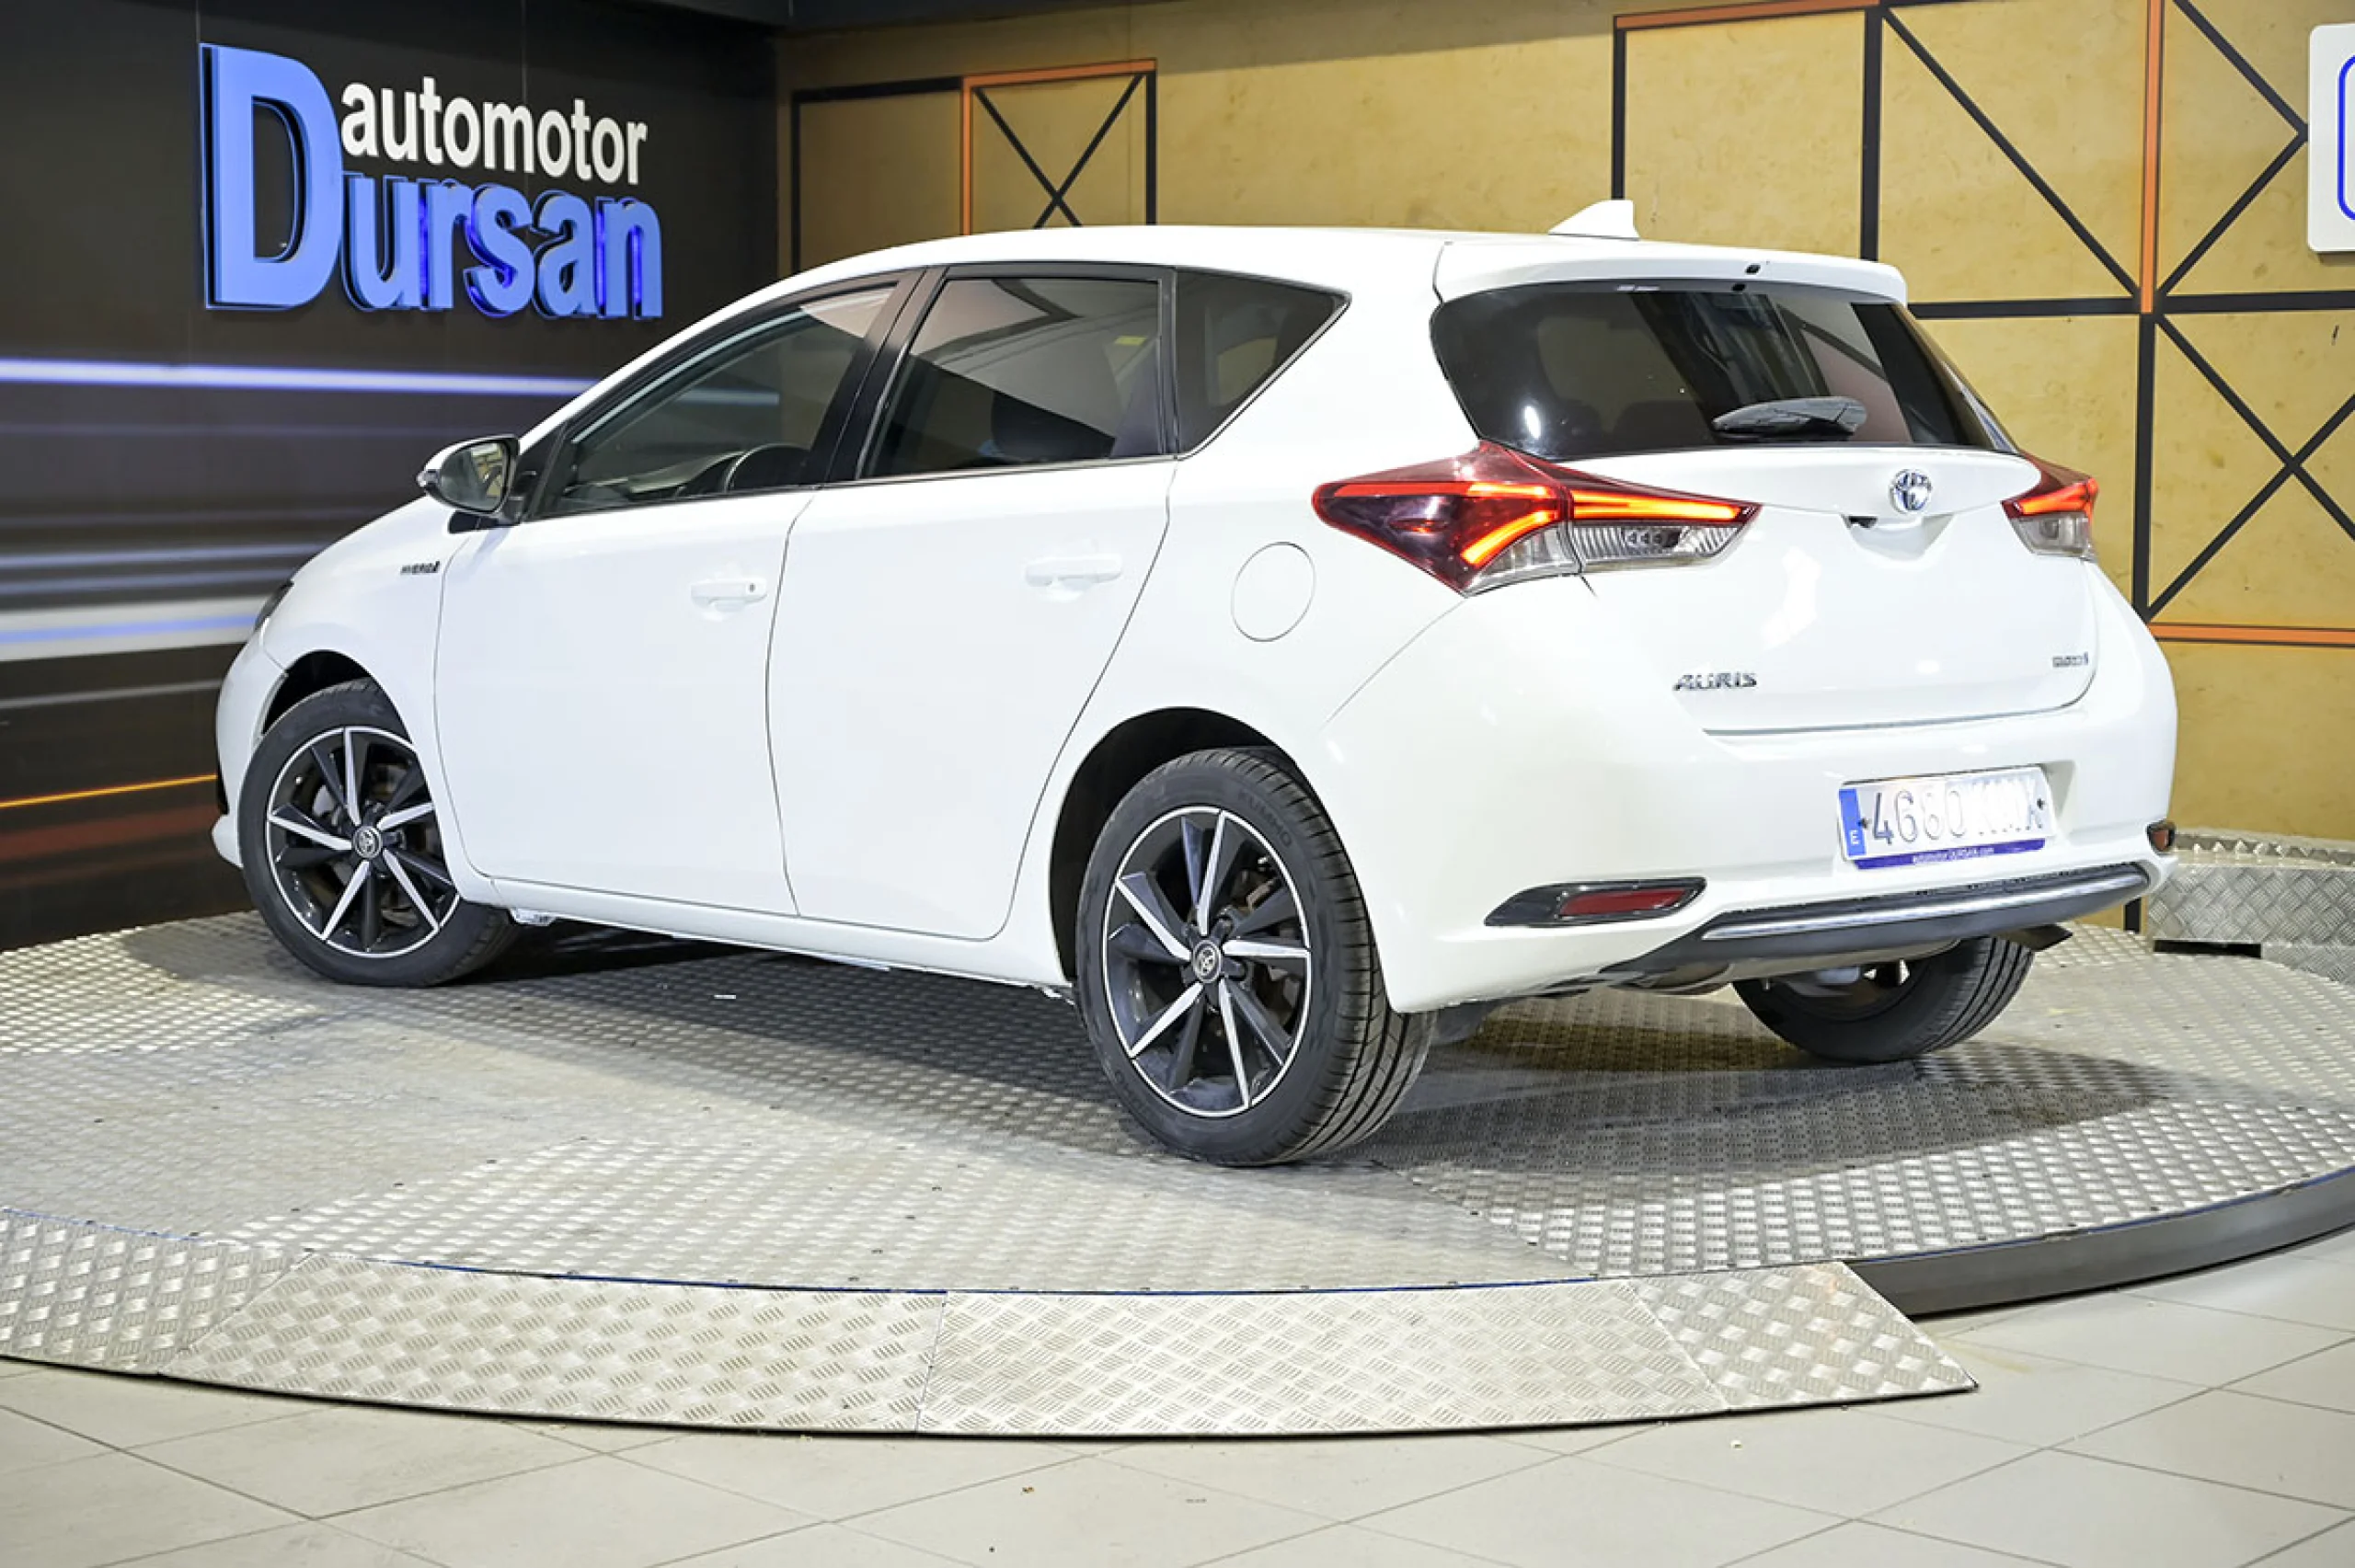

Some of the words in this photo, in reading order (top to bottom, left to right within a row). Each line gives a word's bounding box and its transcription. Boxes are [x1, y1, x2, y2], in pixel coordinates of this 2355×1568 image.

[340, 75, 648, 185] automotor
[199, 42, 663, 319] Dursan
[1672, 671, 1757, 691] AURIS
[1849, 829, 1860, 845] E
